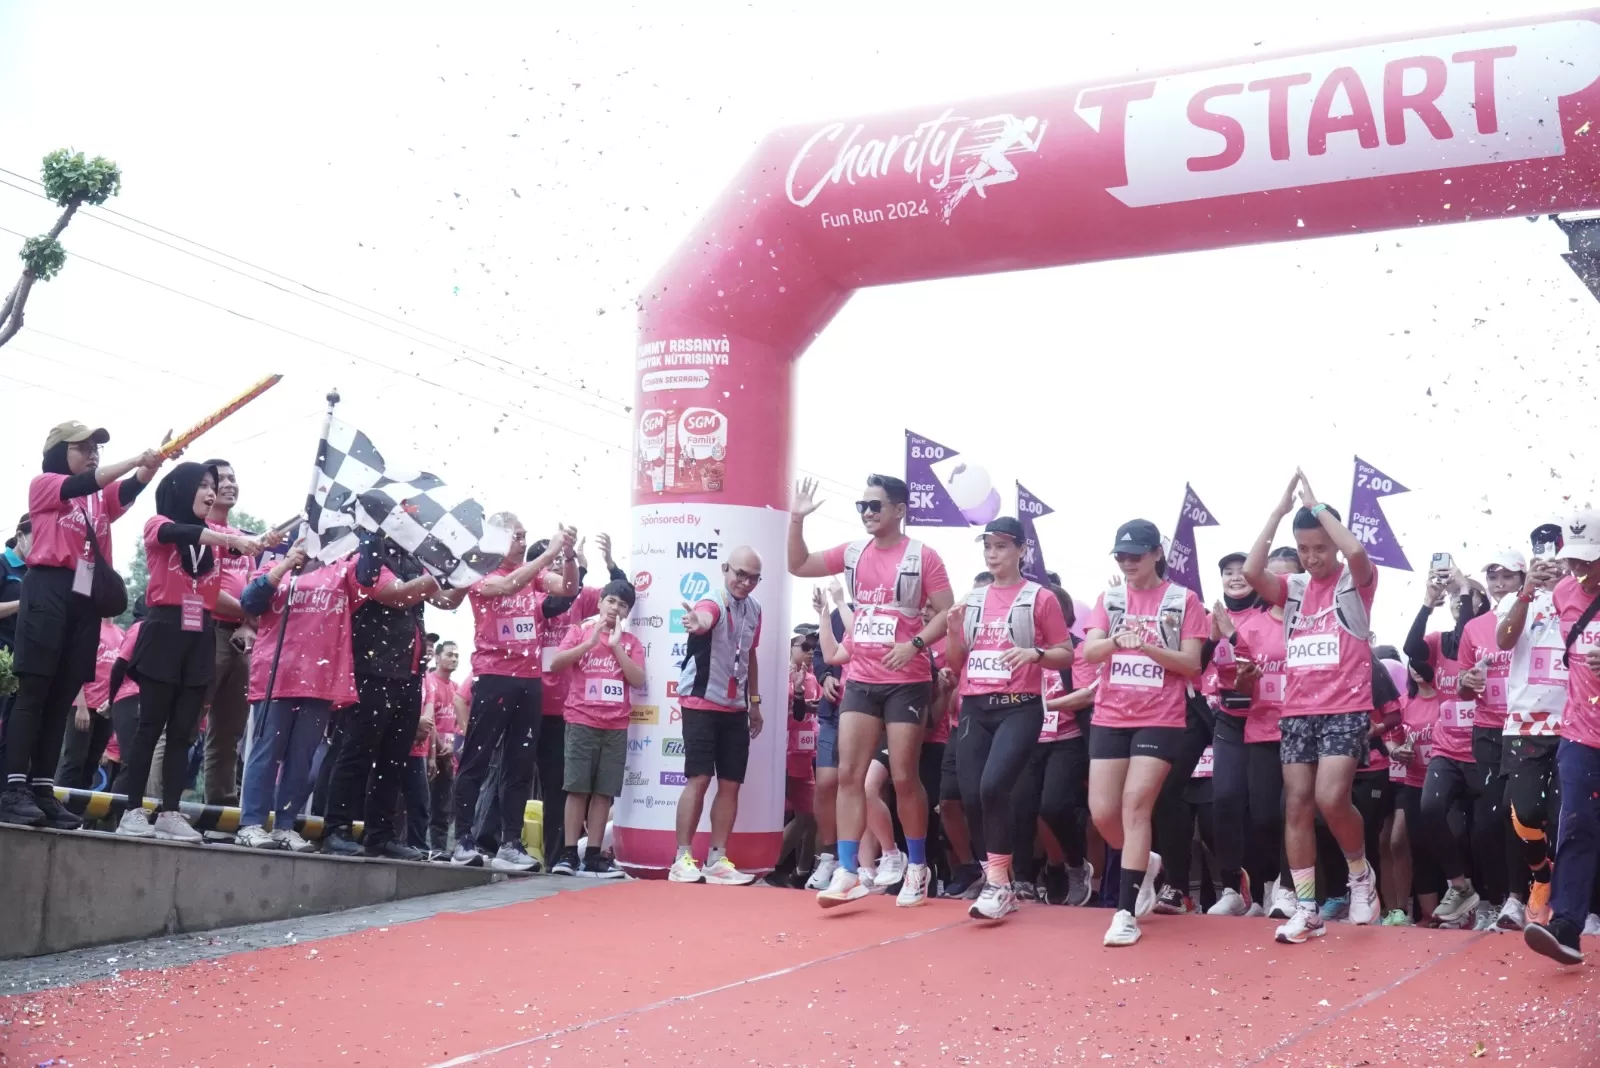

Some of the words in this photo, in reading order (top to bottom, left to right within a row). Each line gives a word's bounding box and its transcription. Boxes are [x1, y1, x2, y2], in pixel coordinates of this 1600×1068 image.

[1186, 45, 1517, 172] START
[785, 108, 969, 208] Charity
[821, 212, 850, 229] Fun
[853, 207, 884, 226] Run
[887, 198, 929, 221] 2024
[670, 338, 730, 353] RASANYA
[664, 353, 729, 365] NUTRISINYA
[644, 415, 664, 432] SGM
[687, 414, 716, 430] SGM
[911, 446, 944, 459] 8.00
[910, 482, 936, 491] Pacer
[1357, 474, 1393, 493] 7.00
[909, 492, 935, 509] 5K
[1019, 499, 1043, 515] 8.00
[640, 513, 685, 528] Sponsored
[687, 513, 701, 527] By
[1183, 502, 1208, 524] 7.00
[1353, 512, 1380, 526] Pacer
[1351, 523, 1379, 545] 5K
[677, 541, 718, 560] NICE
[1173, 539, 1192, 555] Pacer
[1024, 547, 1035, 564] K
[1168, 550, 1189, 574] 5K
[682, 577, 706, 602] hp
[857, 582, 887, 606] harity
[502, 624, 511, 635] A
[516, 623, 534, 633] 037
[855, 622, 894, 636] PACER
[1288, 641, 1338, 660] PACER
[1112, 662, 1163, 680] PACER
[1534, 657, 1544, 670] B
[589, 684, 597, 695] A
[604, 685, 623, 696] 033
[1265, 682, 1275, 693] B
[1492, 685, 1500, 697] B
[1444, 708, 1452, 720] B
